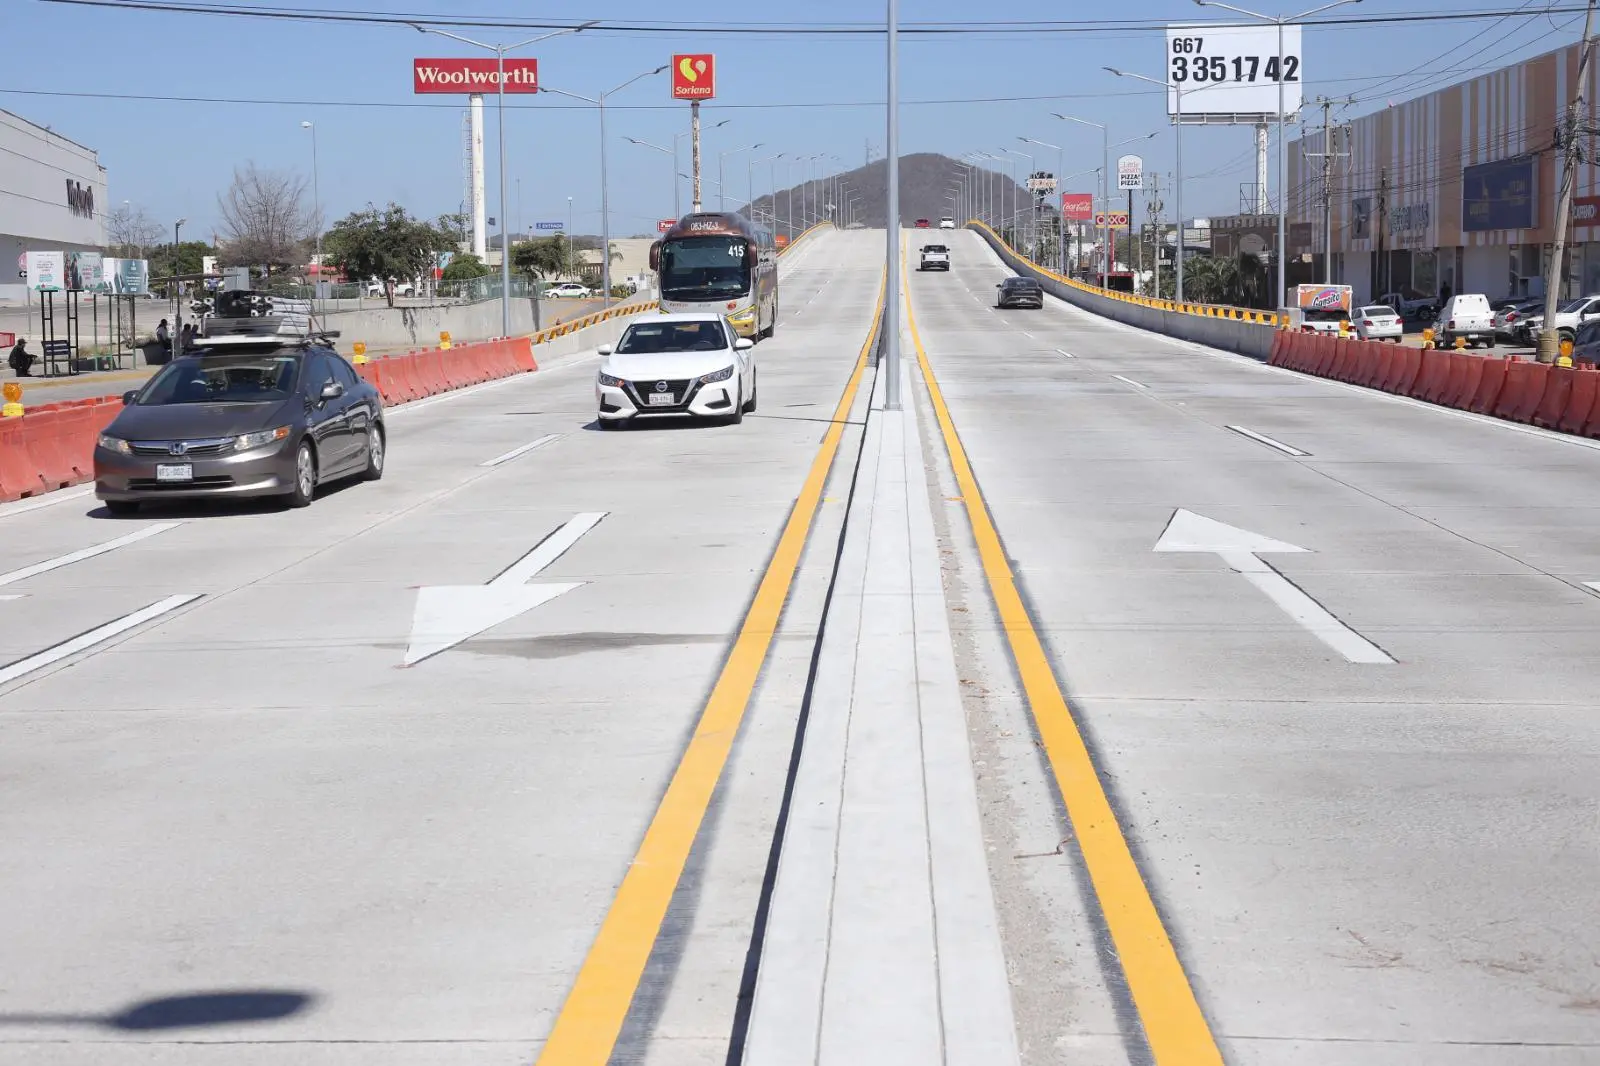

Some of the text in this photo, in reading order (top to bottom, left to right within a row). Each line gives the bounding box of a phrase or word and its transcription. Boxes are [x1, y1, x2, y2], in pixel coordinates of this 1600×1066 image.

[1172, 37, 1203, 54] 667
[416, 67, 535, 84] Woolworth
[675, 85, 711, 95] Soriana
[728, 245, 744, 257] 415
